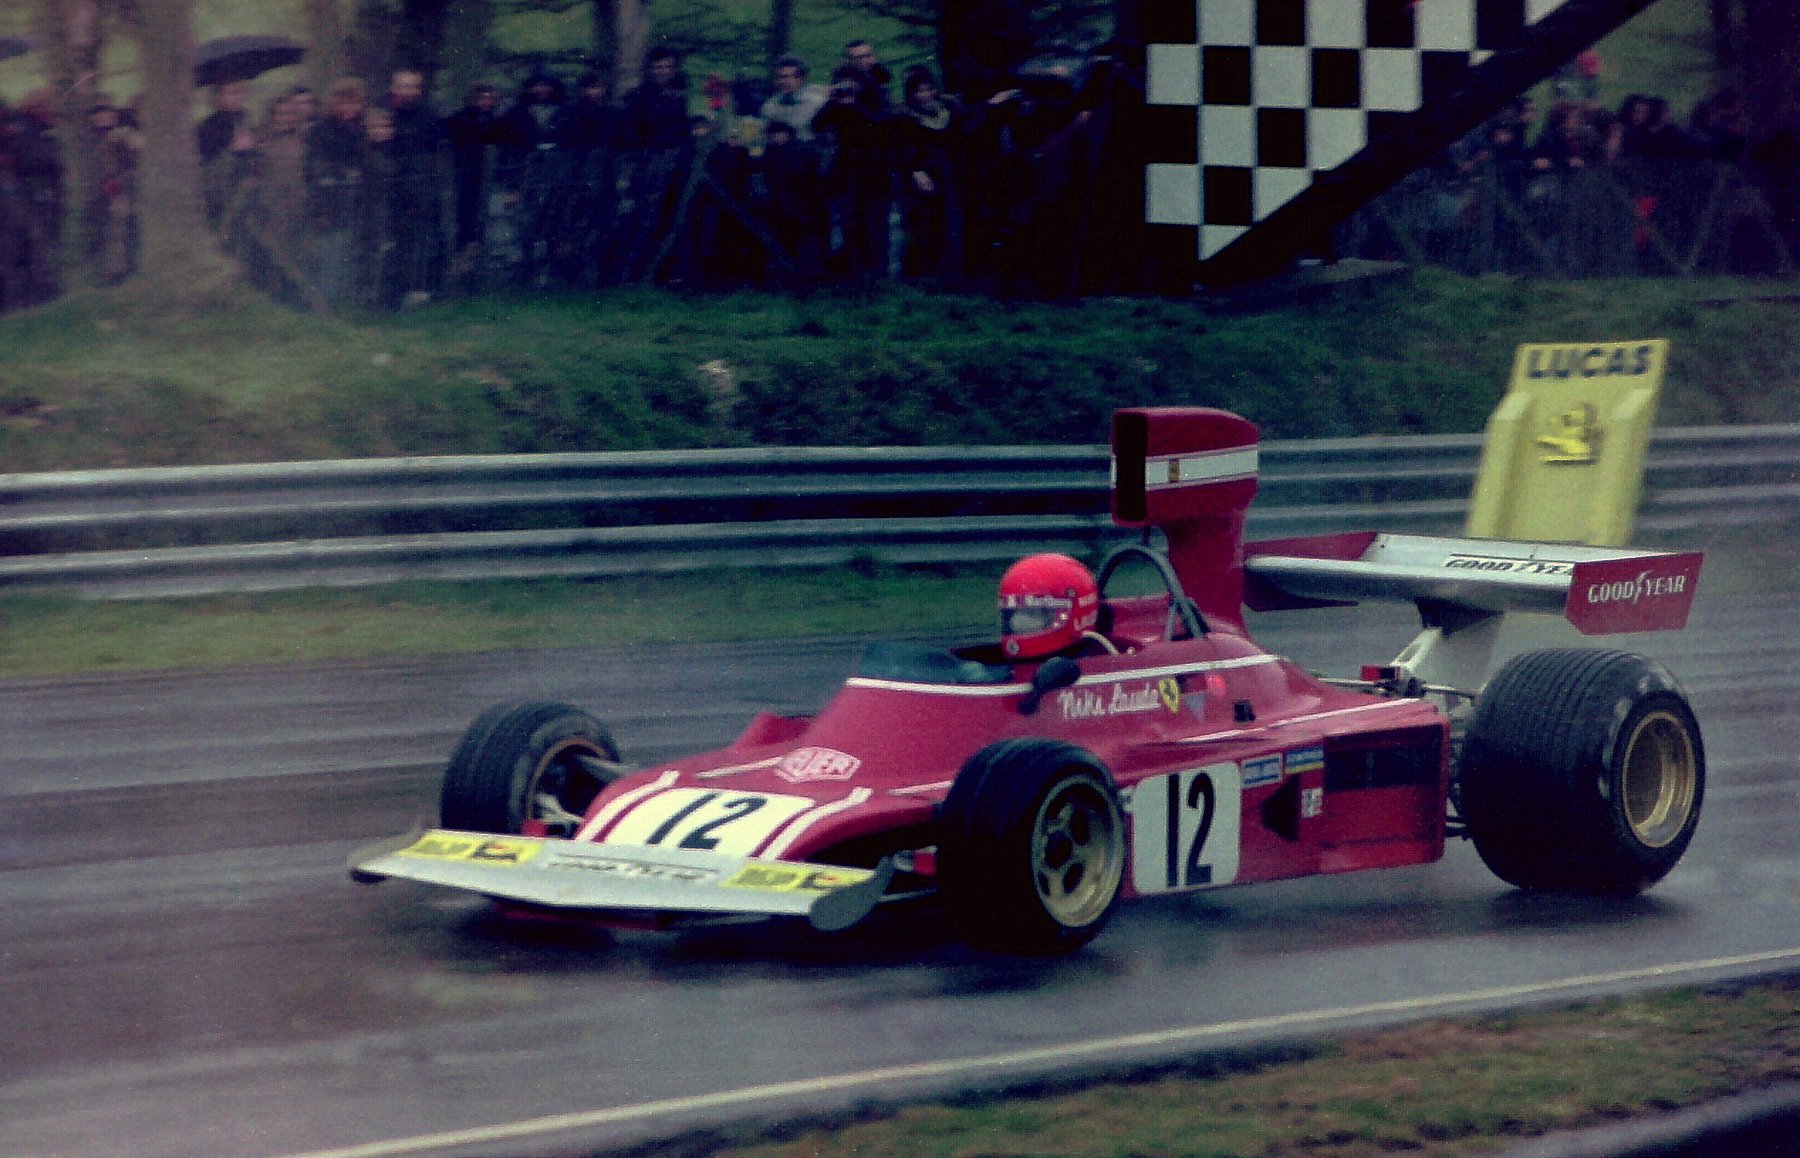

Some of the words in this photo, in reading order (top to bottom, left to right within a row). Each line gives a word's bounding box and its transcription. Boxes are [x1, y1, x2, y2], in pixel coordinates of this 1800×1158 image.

[1528, 345, 1653, 379] LUCAS
[1587, 569, 1685, 605] GOODYEAR
[646, 792, 768, 849] 12
[1167, 771, 1215, 887] 12
